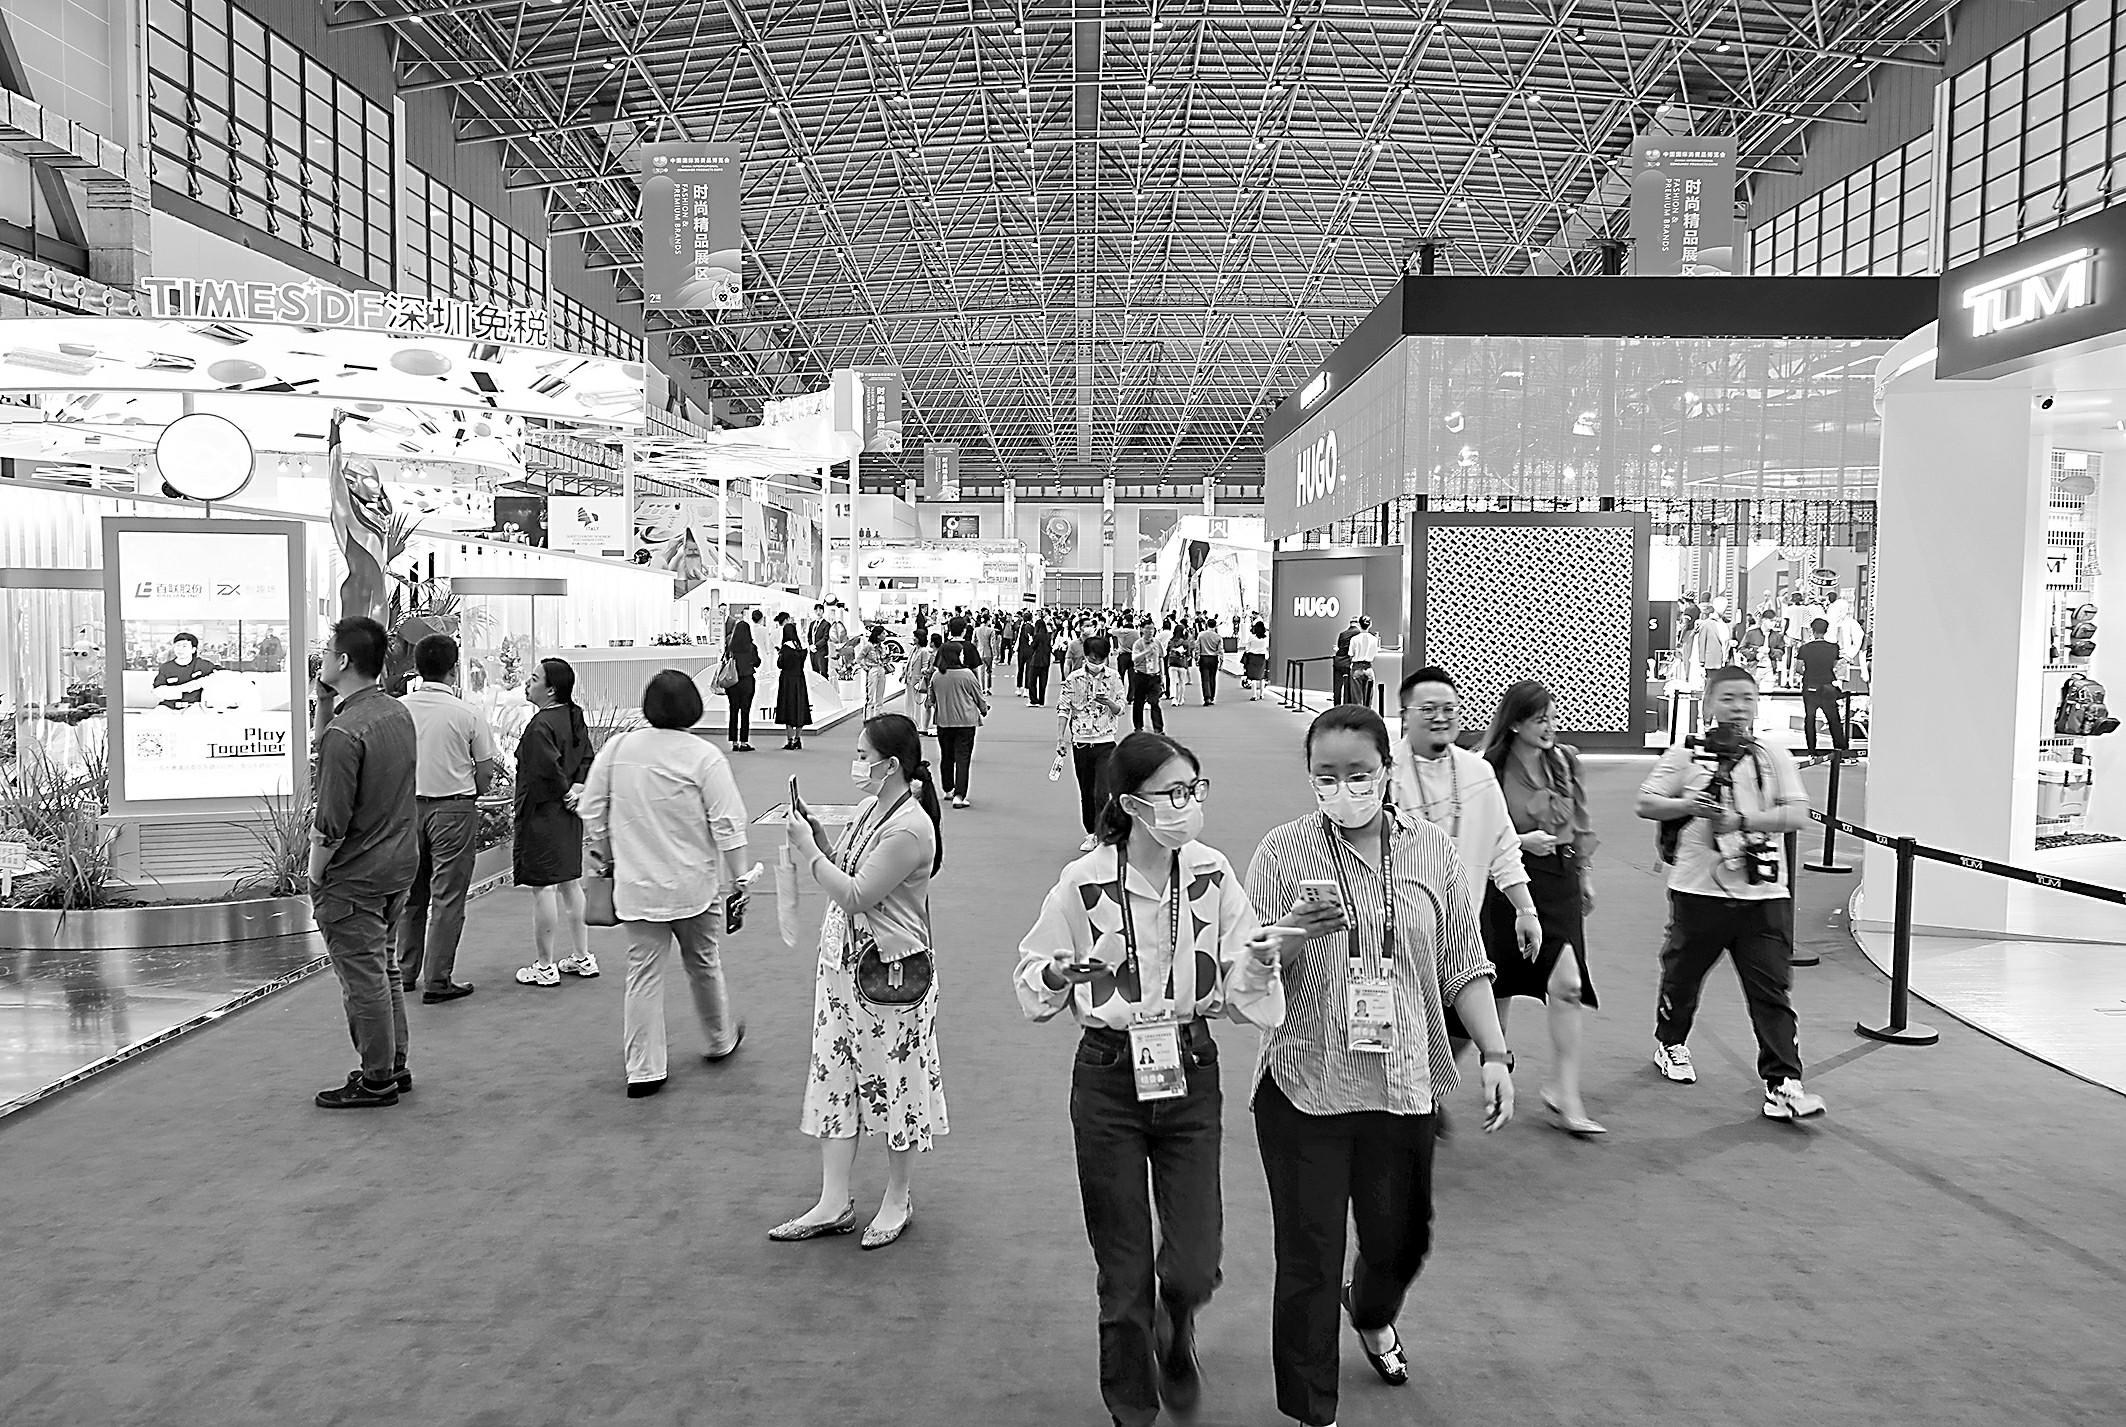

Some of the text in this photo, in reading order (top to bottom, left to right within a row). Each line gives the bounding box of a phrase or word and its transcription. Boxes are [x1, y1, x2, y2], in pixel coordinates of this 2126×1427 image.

[673, 183, 682, 255] PREMIUM BRANDS
[681, 184, 689, 218] FASHION
[1662, 179, 1672, 252] PREMIUM BRANDS
[1671, 179, 1681, 224] FASHION &
[693, 184, 709, 280] 时尚精品展区
[1681, 179, 1702, 276] 时尚精品展区
[1962, 247, 2096, 338] TUMI
[386, 292, 547, 347] 深圳免税
[1296, 430, 1338, 508] HUGO
[1293, 596, 1340, 618] HUGO
[206, 741, 286, 758] Together
[244, 727, 286, 743] Play
[1959, 856, 1983, 870] TUMI
[2035, 874, 2062, 888] TUMI
